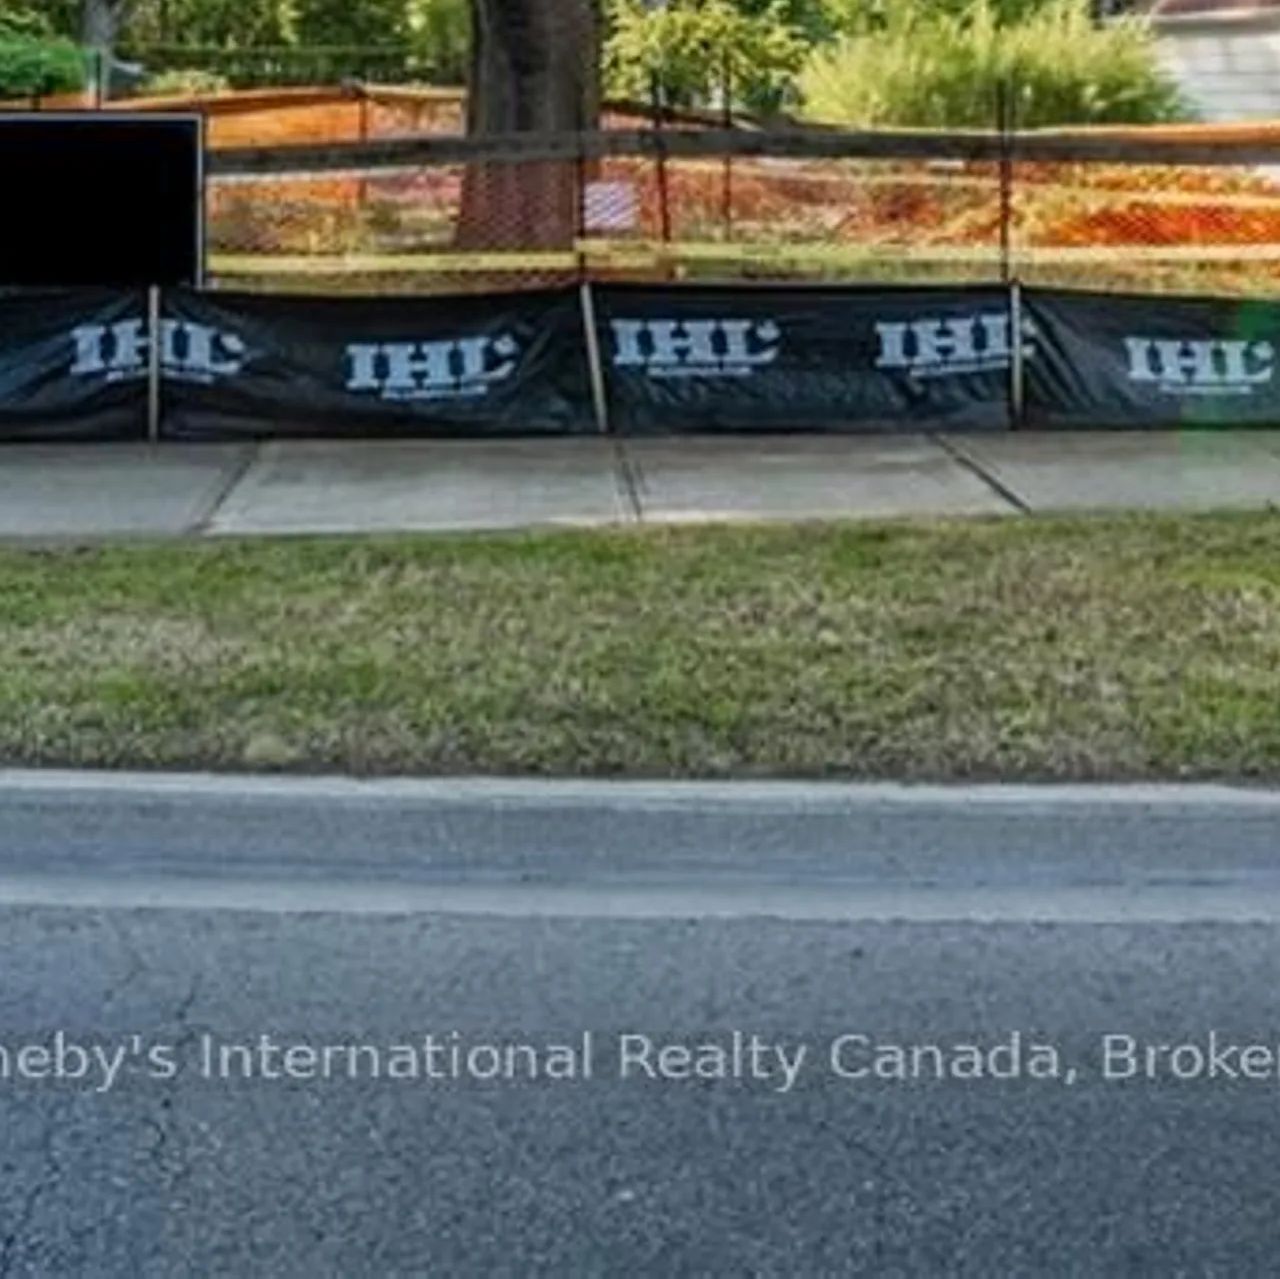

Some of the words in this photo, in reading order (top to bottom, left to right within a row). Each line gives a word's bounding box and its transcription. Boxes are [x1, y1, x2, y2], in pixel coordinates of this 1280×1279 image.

[346, 336, 517, 389] IHL
[610, 318, 780, 365] IHL
[1123, 336, 1274, 383] IHL
